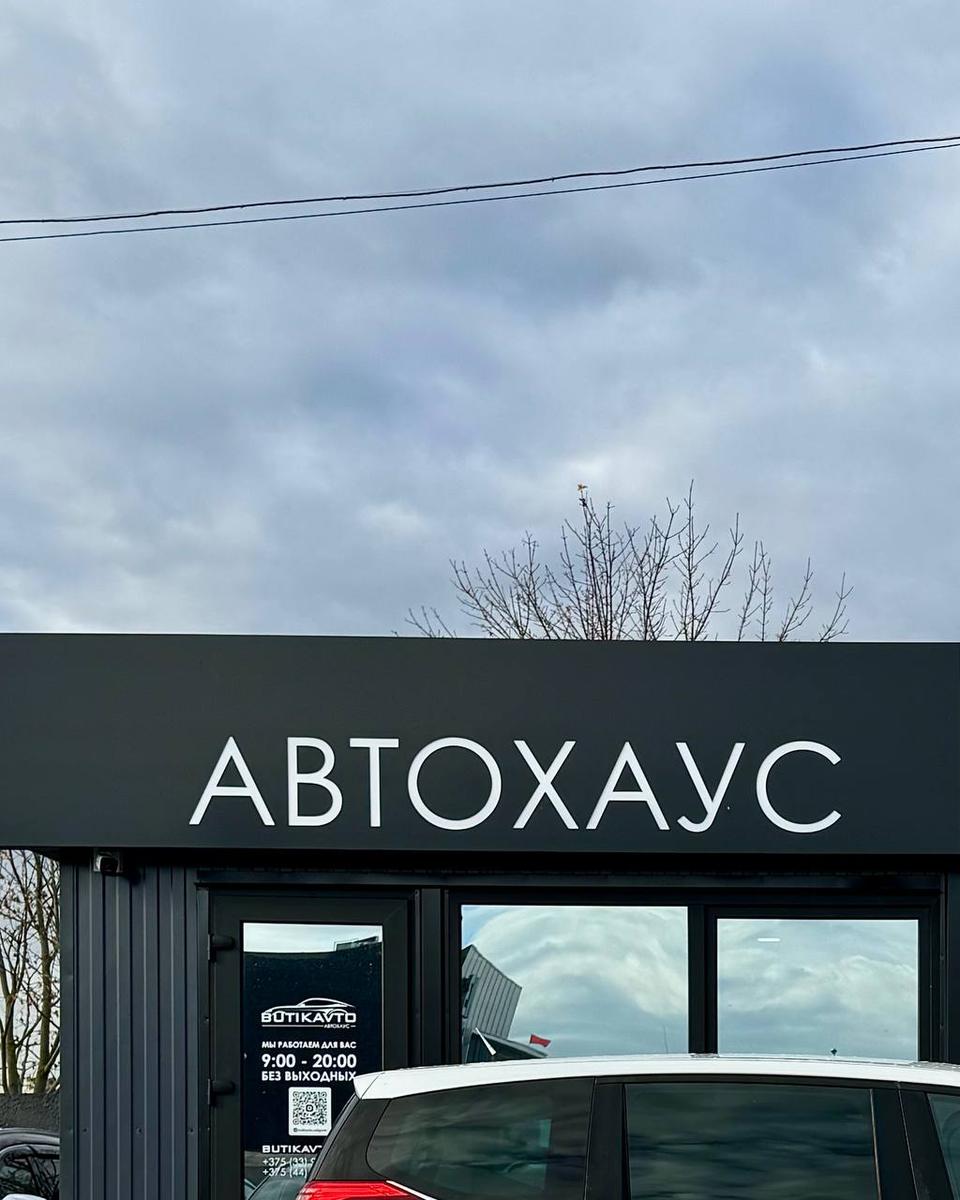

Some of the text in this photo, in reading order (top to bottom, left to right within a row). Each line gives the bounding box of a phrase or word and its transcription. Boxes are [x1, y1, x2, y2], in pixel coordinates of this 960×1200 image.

[189, 735, 842, 833] АВТОХАУС
[261, 1012, 356, 1023] BUTIKAVTO
[262, 1041, 356, 1049] МЫ РАБОТАЕМ ДЛЯ ВАС
[262, 1053, 296, 1068] 9:00
[312, 1053, 357, 1068] 20:00
[262, 1071, 356, 1082] БЕЗ ВЫХОДНЫХ
[262, 1157, 287, 1167] +375
[289, 1157, 307, 1168] (33)
[262, 1167, 307, 1178] +375 (44)
